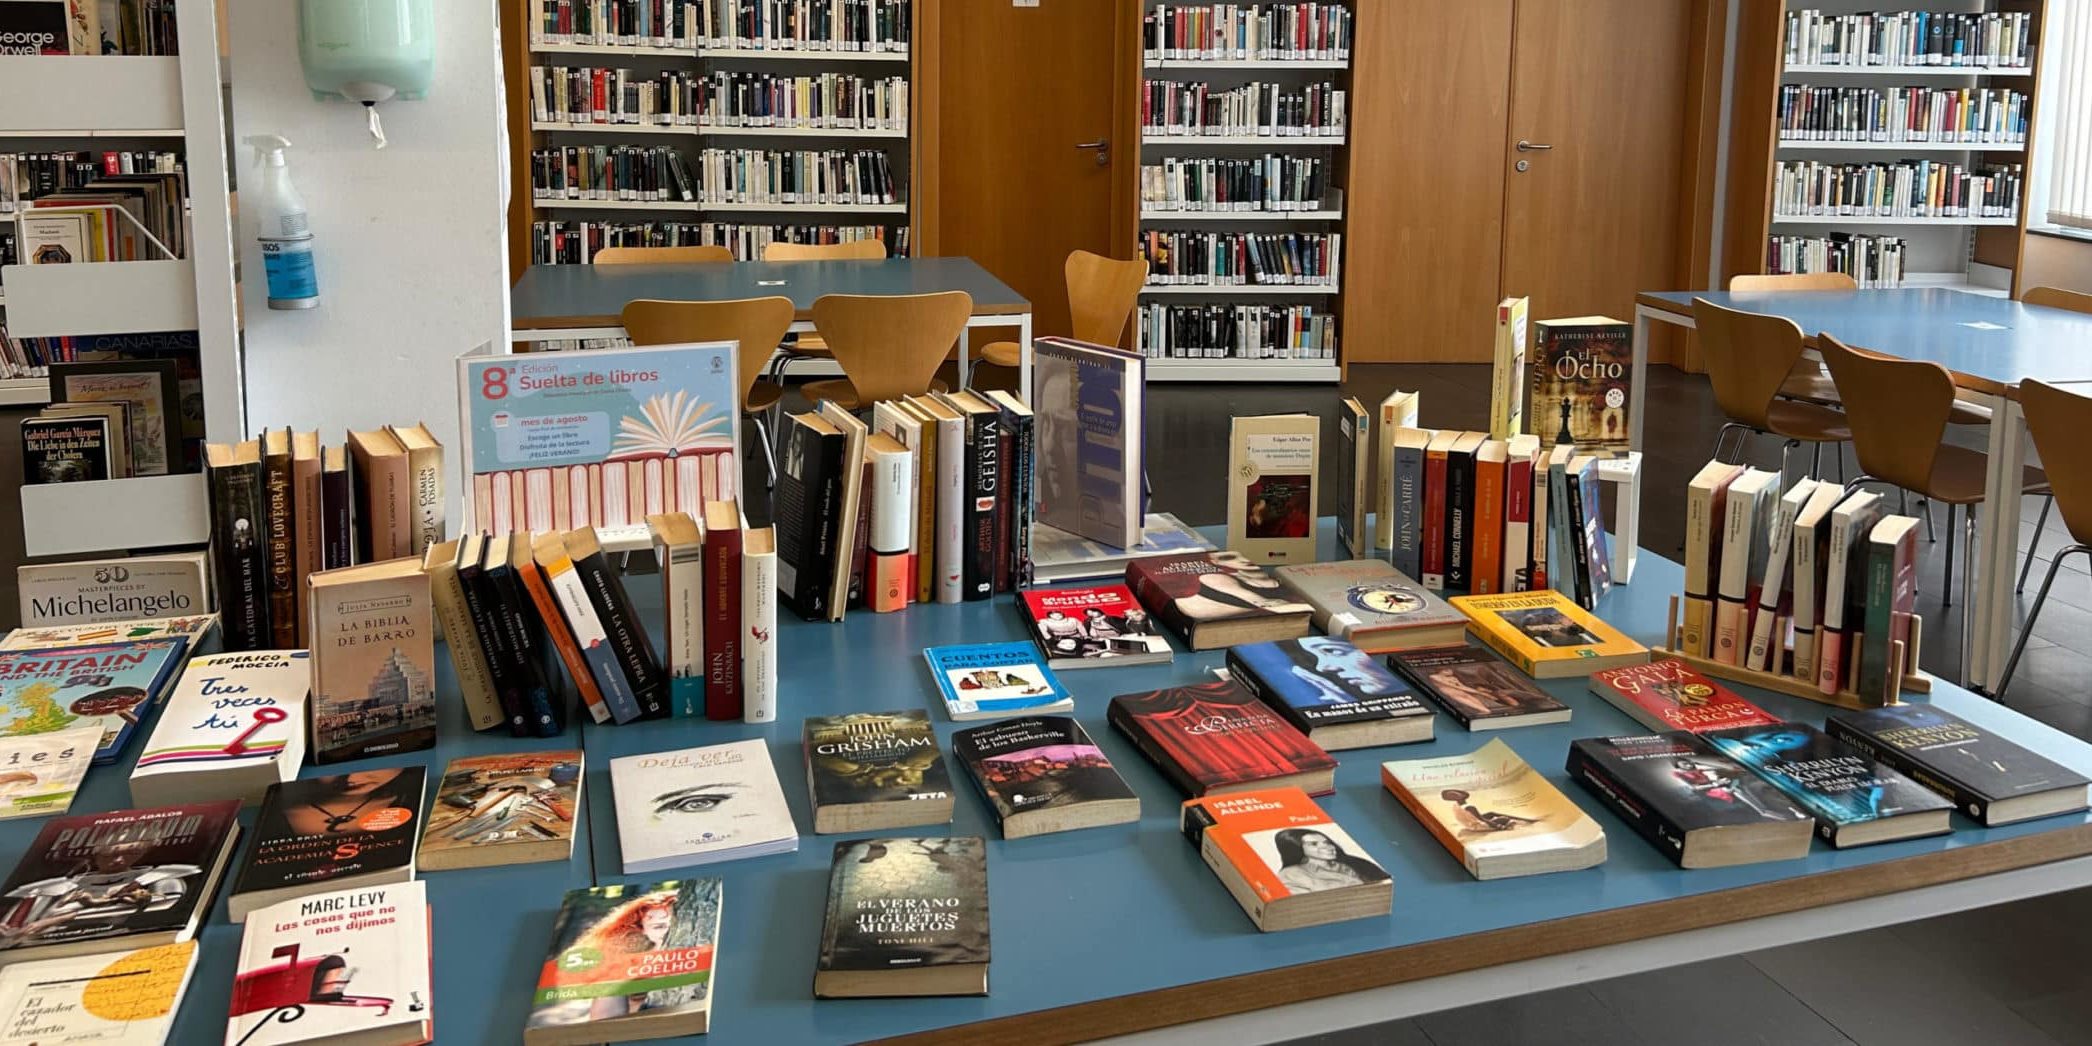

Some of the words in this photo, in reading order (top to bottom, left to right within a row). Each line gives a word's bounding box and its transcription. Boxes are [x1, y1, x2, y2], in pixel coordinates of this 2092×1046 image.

[0, 31, 54, 45] eorge
[96, 334, 193, 350] CANARIAS
[521, 364, 558, 374] Edición
[1556, 350, 1622, 380] Ocho
[520, 375, 577, 390] Suelta
[583, 372, 604, 386] de
[610, 369, 658, 384] libros
[542, 417, 554, 425] de
[557, 416, 588, 424] agosto
[25, 428, 49, 440] Gabriel
[28, 441, 39, 451] Die
[40, 440, 58, 450] Liebe
[67, 439, 78, 448] den
[47, 452, 56, 460] der
[58, 451, 83, 460] Cholera
[983, 421, 997, 491] GEISHA
[419, 469, 428, 506] CARMEN
[428, 467, 436, 505] POSADAS
[1400, 475, 1413, 514] CARRÉ
[272, 470, 285, 538] LOVECRAFT
[1400, 521, 1412, 551] JOHN
[277, 542, 286, 575] CLUB
[1452, 541, 1461, 567] MICHAEL
[78, 584, 134, 593] MASTERPIECES
[32, 590, 190, 619] Michelangelo
[341, 622, 359, 632] LA
[364, 616, 411, 628] BIBLIA
[610, 613, 624, 628] LA
[337, 636, 359, 647] DE
[364, 629, 415, 644] BARRO
[616, 627, 636, 654] OTRA
[0, 652, 148, 673] BRITAIN
[208, 654, 281, 666] FEDERICO
[941, 651, 1031, 663] CUENTOS
[70, 665, 135, 675] BRITISH
[231, 662, 289, 670] MOCCIA
[626, 653, 649, 684] LEPRA
[712, 652, 723, 684] JOHN
[726, 641, 734, 695] KATZENBACH
[1601, 661, 1680, 680] ANTONIO
[200, 677, 249, 696] Tres
[1612, 668, 1694, 694] GALA
[212, 696, 277, 708] veces
[1304, 711, 1320, 719] En
[1322, 707, 1354, 716] manos
[1355, 705, 1367, 714] de
[1384, 700, 1420, 710] extraño
[192, 714, 238, 729] tú
[1673, 710, 1738, 725] TURCA
[850, 733, 895, 744] JOHN
[972, 730, 995, 738] Arthur
[997, 725, 1020, 733] Conan
[975, 738, 987, 746] El
[990, 730, 1028, 743] sabueso
[1877, 723, 1966, 741] SHERRILYN
[1891, 728, 1980, 749] KENYON
[817, 737, 931, 754] GRISHAM
[978, 743, 991, 751] de
[993, 739, 1008, 749] los
[1010, 731, 1065, 744] Baskerville
[638, 755, 689, 768] Deja
[1763, 755, 1865, 776] SHERRILYN
[1791, 765, 1870, 783] KENYON
[909, 792, 947, 801] ZETA
[1213, 798, 1263, 809] ISABEL
[1220, 802, 1284, 816] ALLENDE
[94, 816, 135, 825] RAFAEL
[259, 846, 275, 854] LA
[278, 839, 333, 851] ORDEN
[255, 850, 333, 865] ACADEMIA
[301, 897, 345, 917] MARC
[349, 891, 386, 910] LEVY
[856, 901, 876, 909] EL
[879, 898, 959, 909] VERANO
[275, 921, 299, 933] Las
[302, 916, 347, 927] cosas
[351, 912, 373, 924] que
[379, 907, 397, 916] no
[856, 912, 959, 924] JUGUETES
[315, 925, 341, 936] nos
[343, 917, 396, 933] dijimos
[859, 921, 956, 933] MUERTOS
[643, 950, 699, 964] PAULO
[627, 962, 697, 977] COELHO
[546, 989, 577, 1000] Brida
[20, 1004, 77, 1016] cazador
[26, 997, 43, 1008] El
[15, 1016, 38, 1027] del
[8, 1025, 65, 1038] desierto
